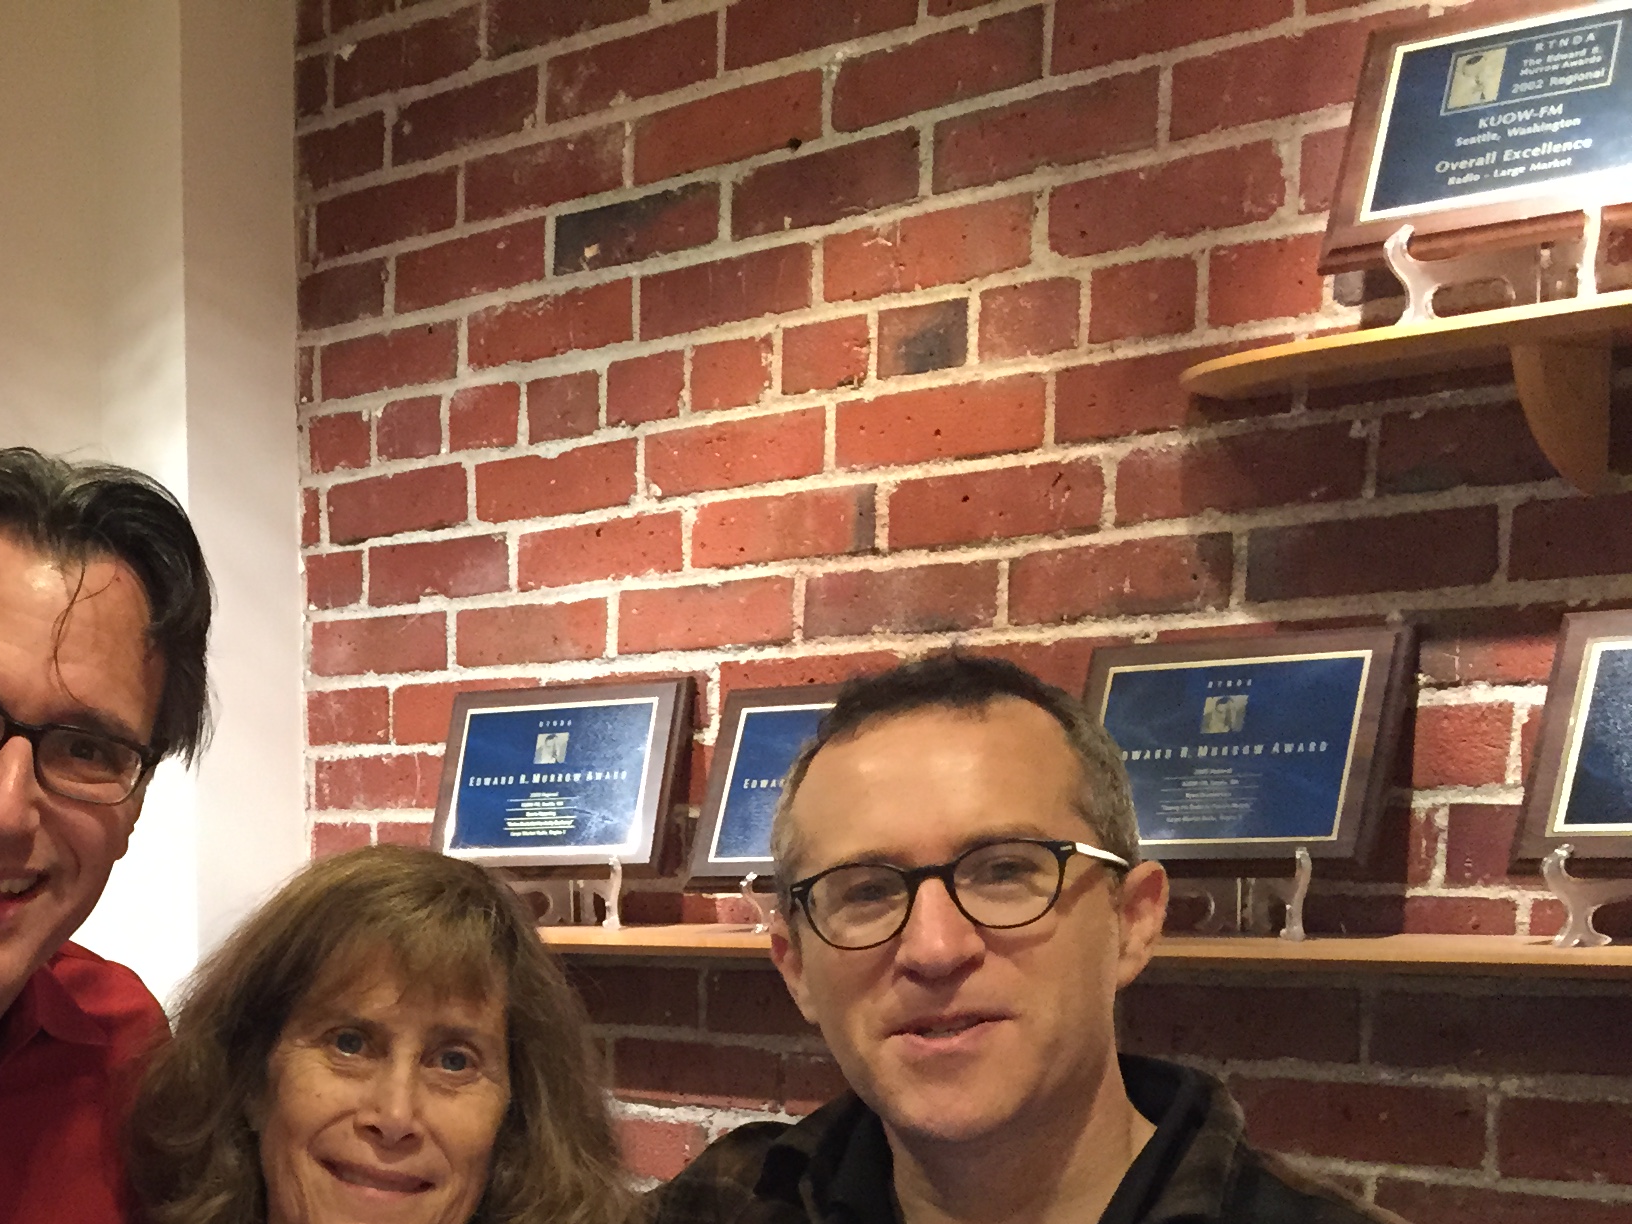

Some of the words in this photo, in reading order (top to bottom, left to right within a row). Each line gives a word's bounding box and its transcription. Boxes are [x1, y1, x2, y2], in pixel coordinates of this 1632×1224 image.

[1523, 58, 1543, 67] The
[1549, 67, 1606, 86] Regional
[1478, 103, 1564, 129] KUOW-FM
[1507, 117, 1582, 138] Washington
[1435, 151, 1498, 173] Overall
[1503, 138, 1594, 162] Excellence
[1447, 172, 1481, 186] Radio
[1493, 165, 1527, 178] Large
[1529, 157, 1573, 172] Market
[1121, 748, 1172, 761] DWARD
[743, 778, 785, 789] EDWA
